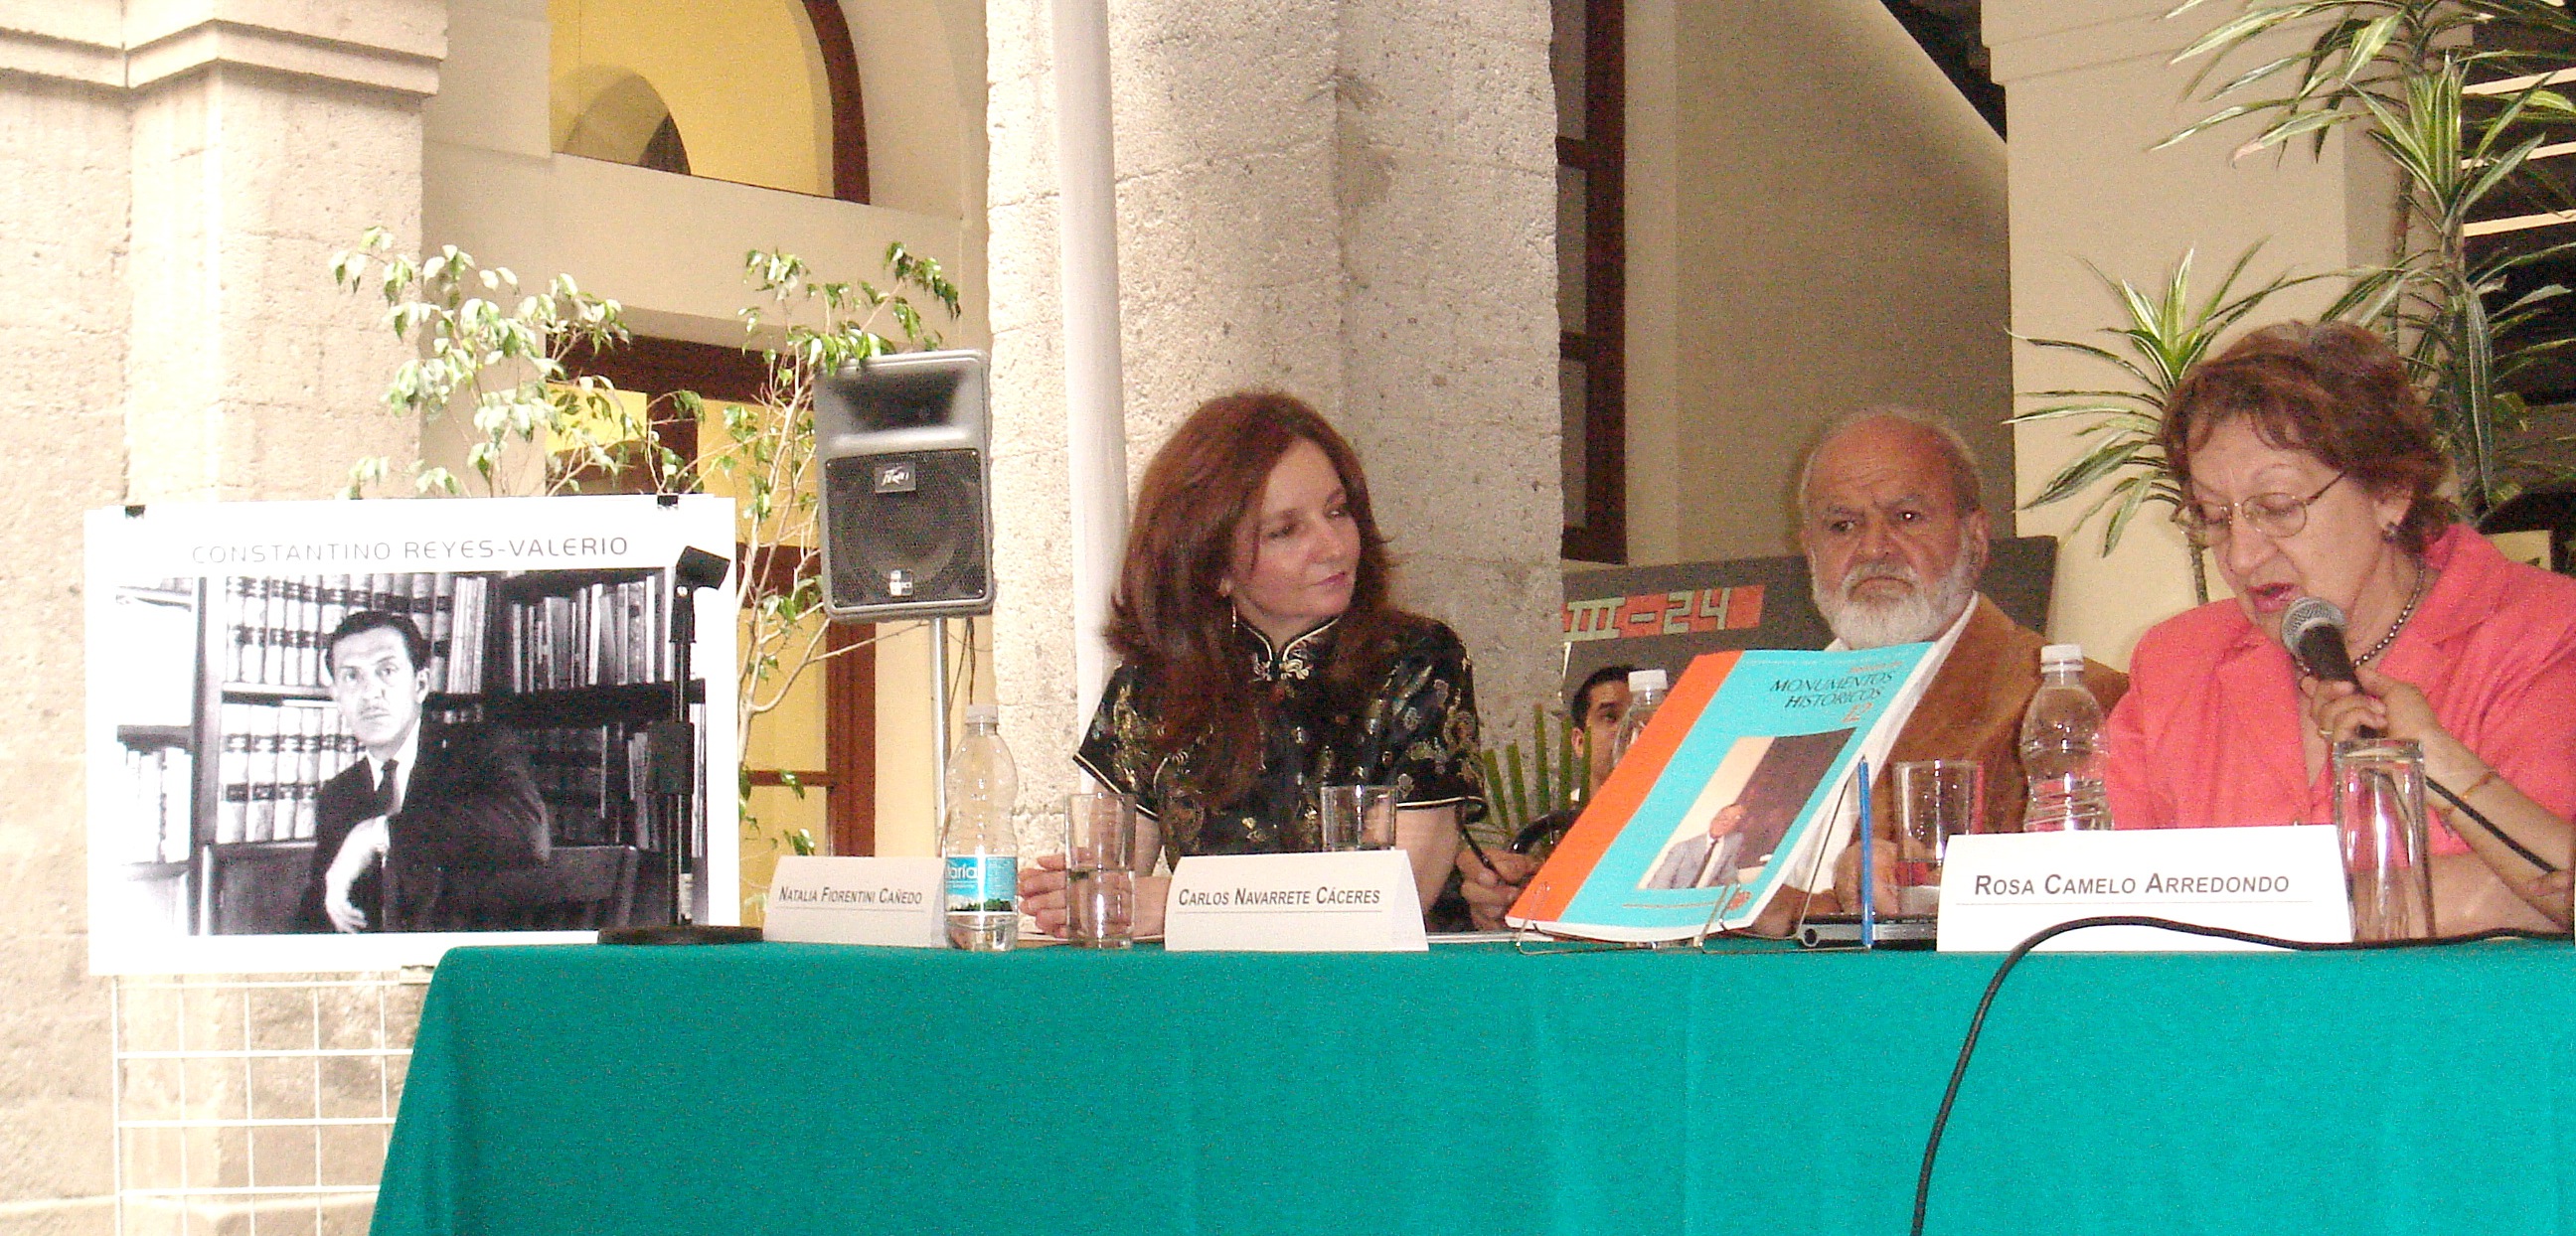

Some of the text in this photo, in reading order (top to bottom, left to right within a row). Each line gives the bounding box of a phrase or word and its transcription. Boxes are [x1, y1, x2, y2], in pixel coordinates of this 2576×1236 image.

[193, 537, 628, 563] CONSTANTINO REYES-VALERIO
[1770, 671, 1895, 693] MONUMENTOS
